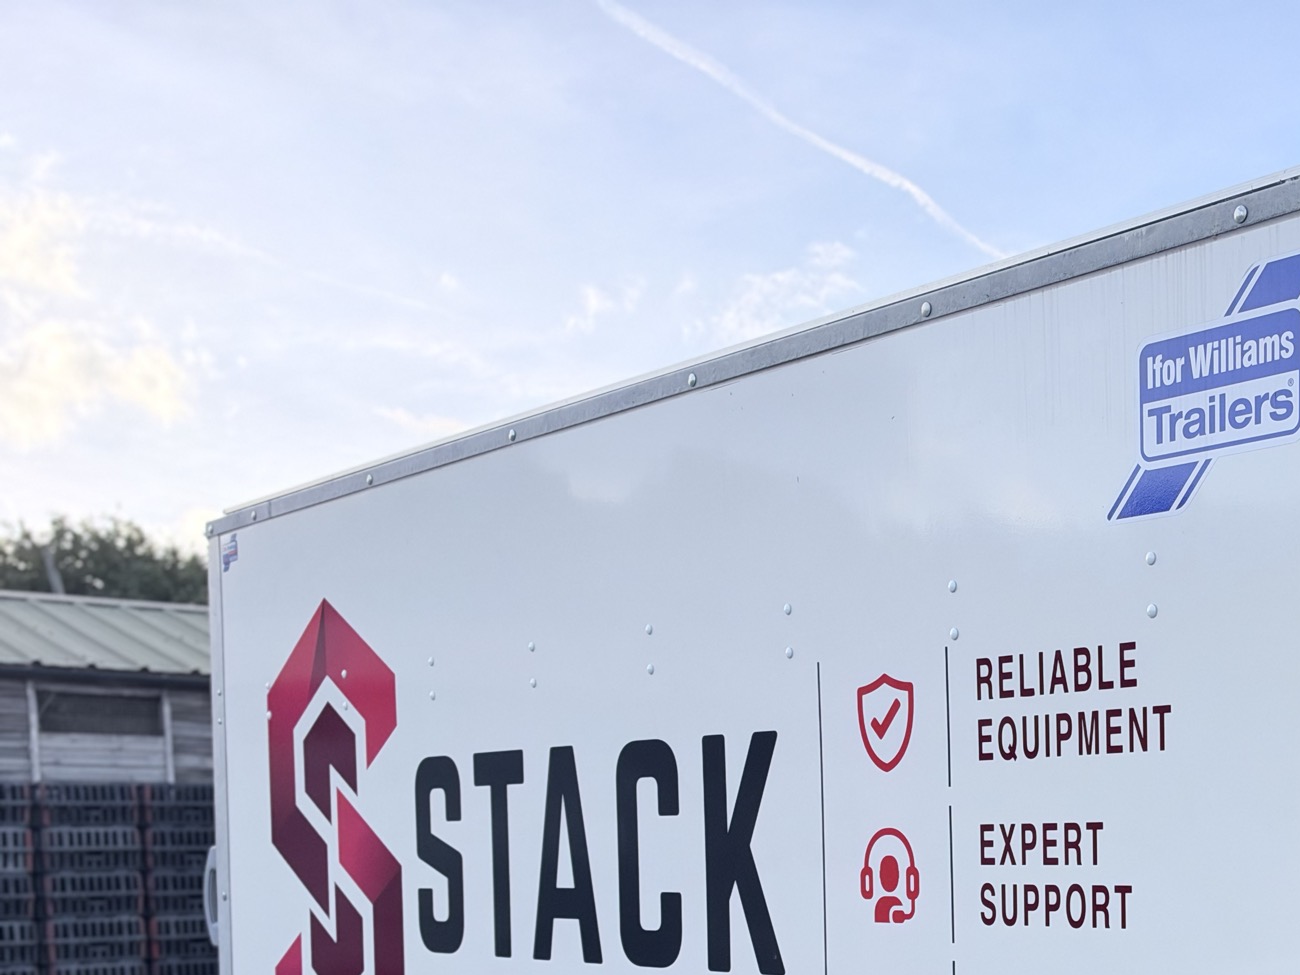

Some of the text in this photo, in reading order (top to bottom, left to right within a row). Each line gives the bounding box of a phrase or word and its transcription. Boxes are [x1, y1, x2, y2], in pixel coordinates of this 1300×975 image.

[1147, 330, 1295, 389] Ifor Williams
[1148, 388, 1294, 445] Trailers
[976, 641, 1138, 701] RELIABLE
[977, 704, 1172, 762] EQUIPMENT
[980, 821, 1104, 866] EXPERT
[980, 882, 1133, 930] SUPPORT
